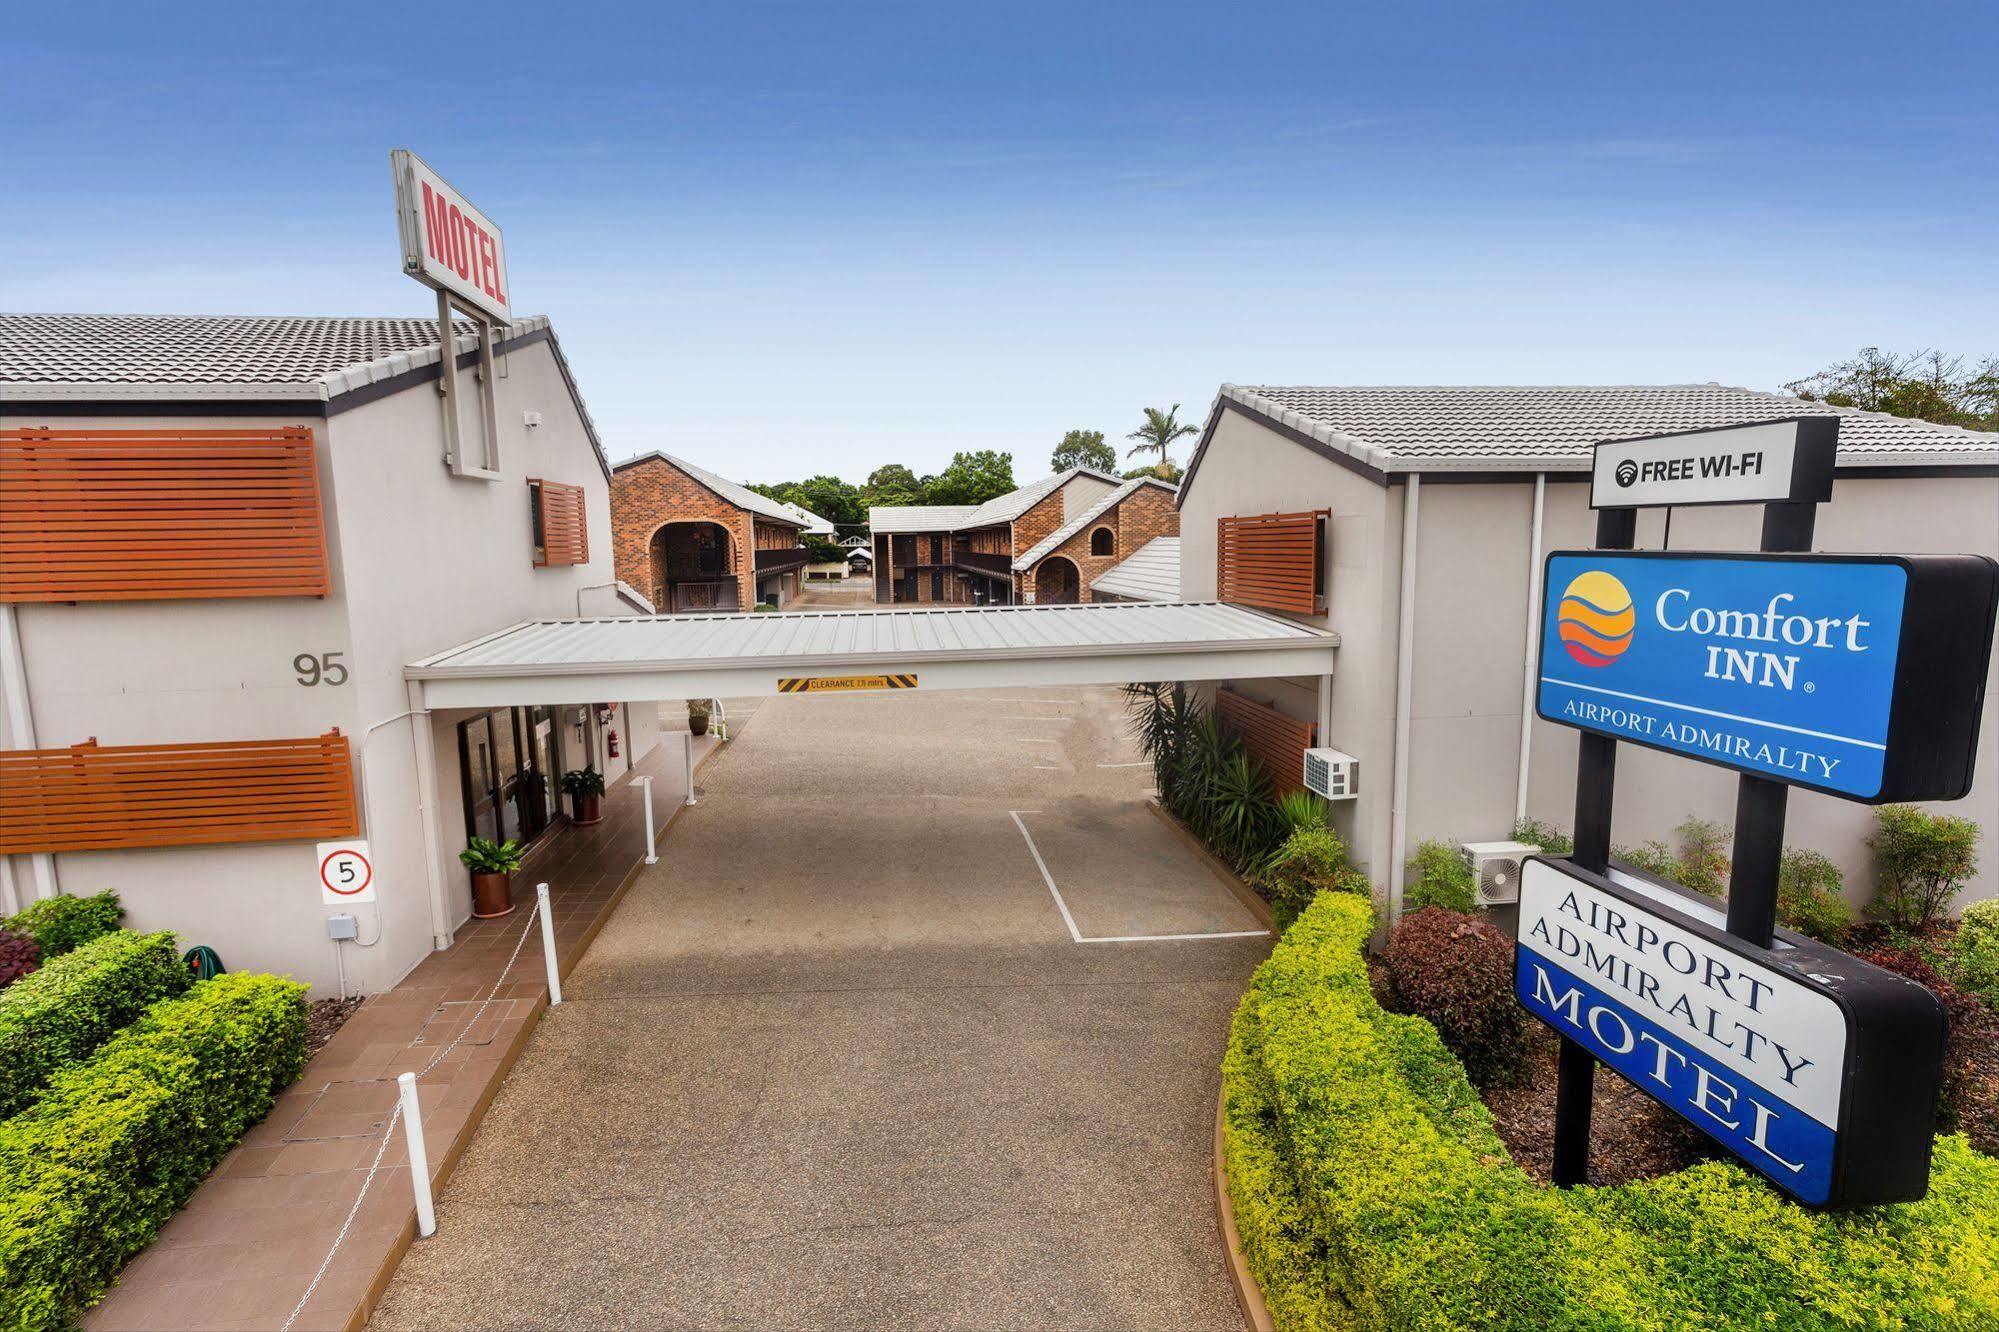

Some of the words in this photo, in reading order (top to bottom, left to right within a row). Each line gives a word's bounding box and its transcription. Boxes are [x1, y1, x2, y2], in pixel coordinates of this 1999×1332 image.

[421, 180, 507, 306] MOTEL
[1641, 458, 1695, 482] FREE
[1699, 451, 1763, 479] WI-FI
[1655, 588, 1870, 652] Comfort
[293, 652, 348, 687] 95
[811, 679, 855, 689] CLEARANCE
[1704, 645, 1800, 691] INN
[1564, 699, 1657, 734] AIRPORT
[1661, 721, 1841, 779] ADMIRALTY
[339, 861, 355, 883] 5
[1558, 891, 1774, 1014] AIRPORT
[1530, 916, 1815, 1088] ADMIRALTY
[1531, 964, 1805, 1173] MOTEL
